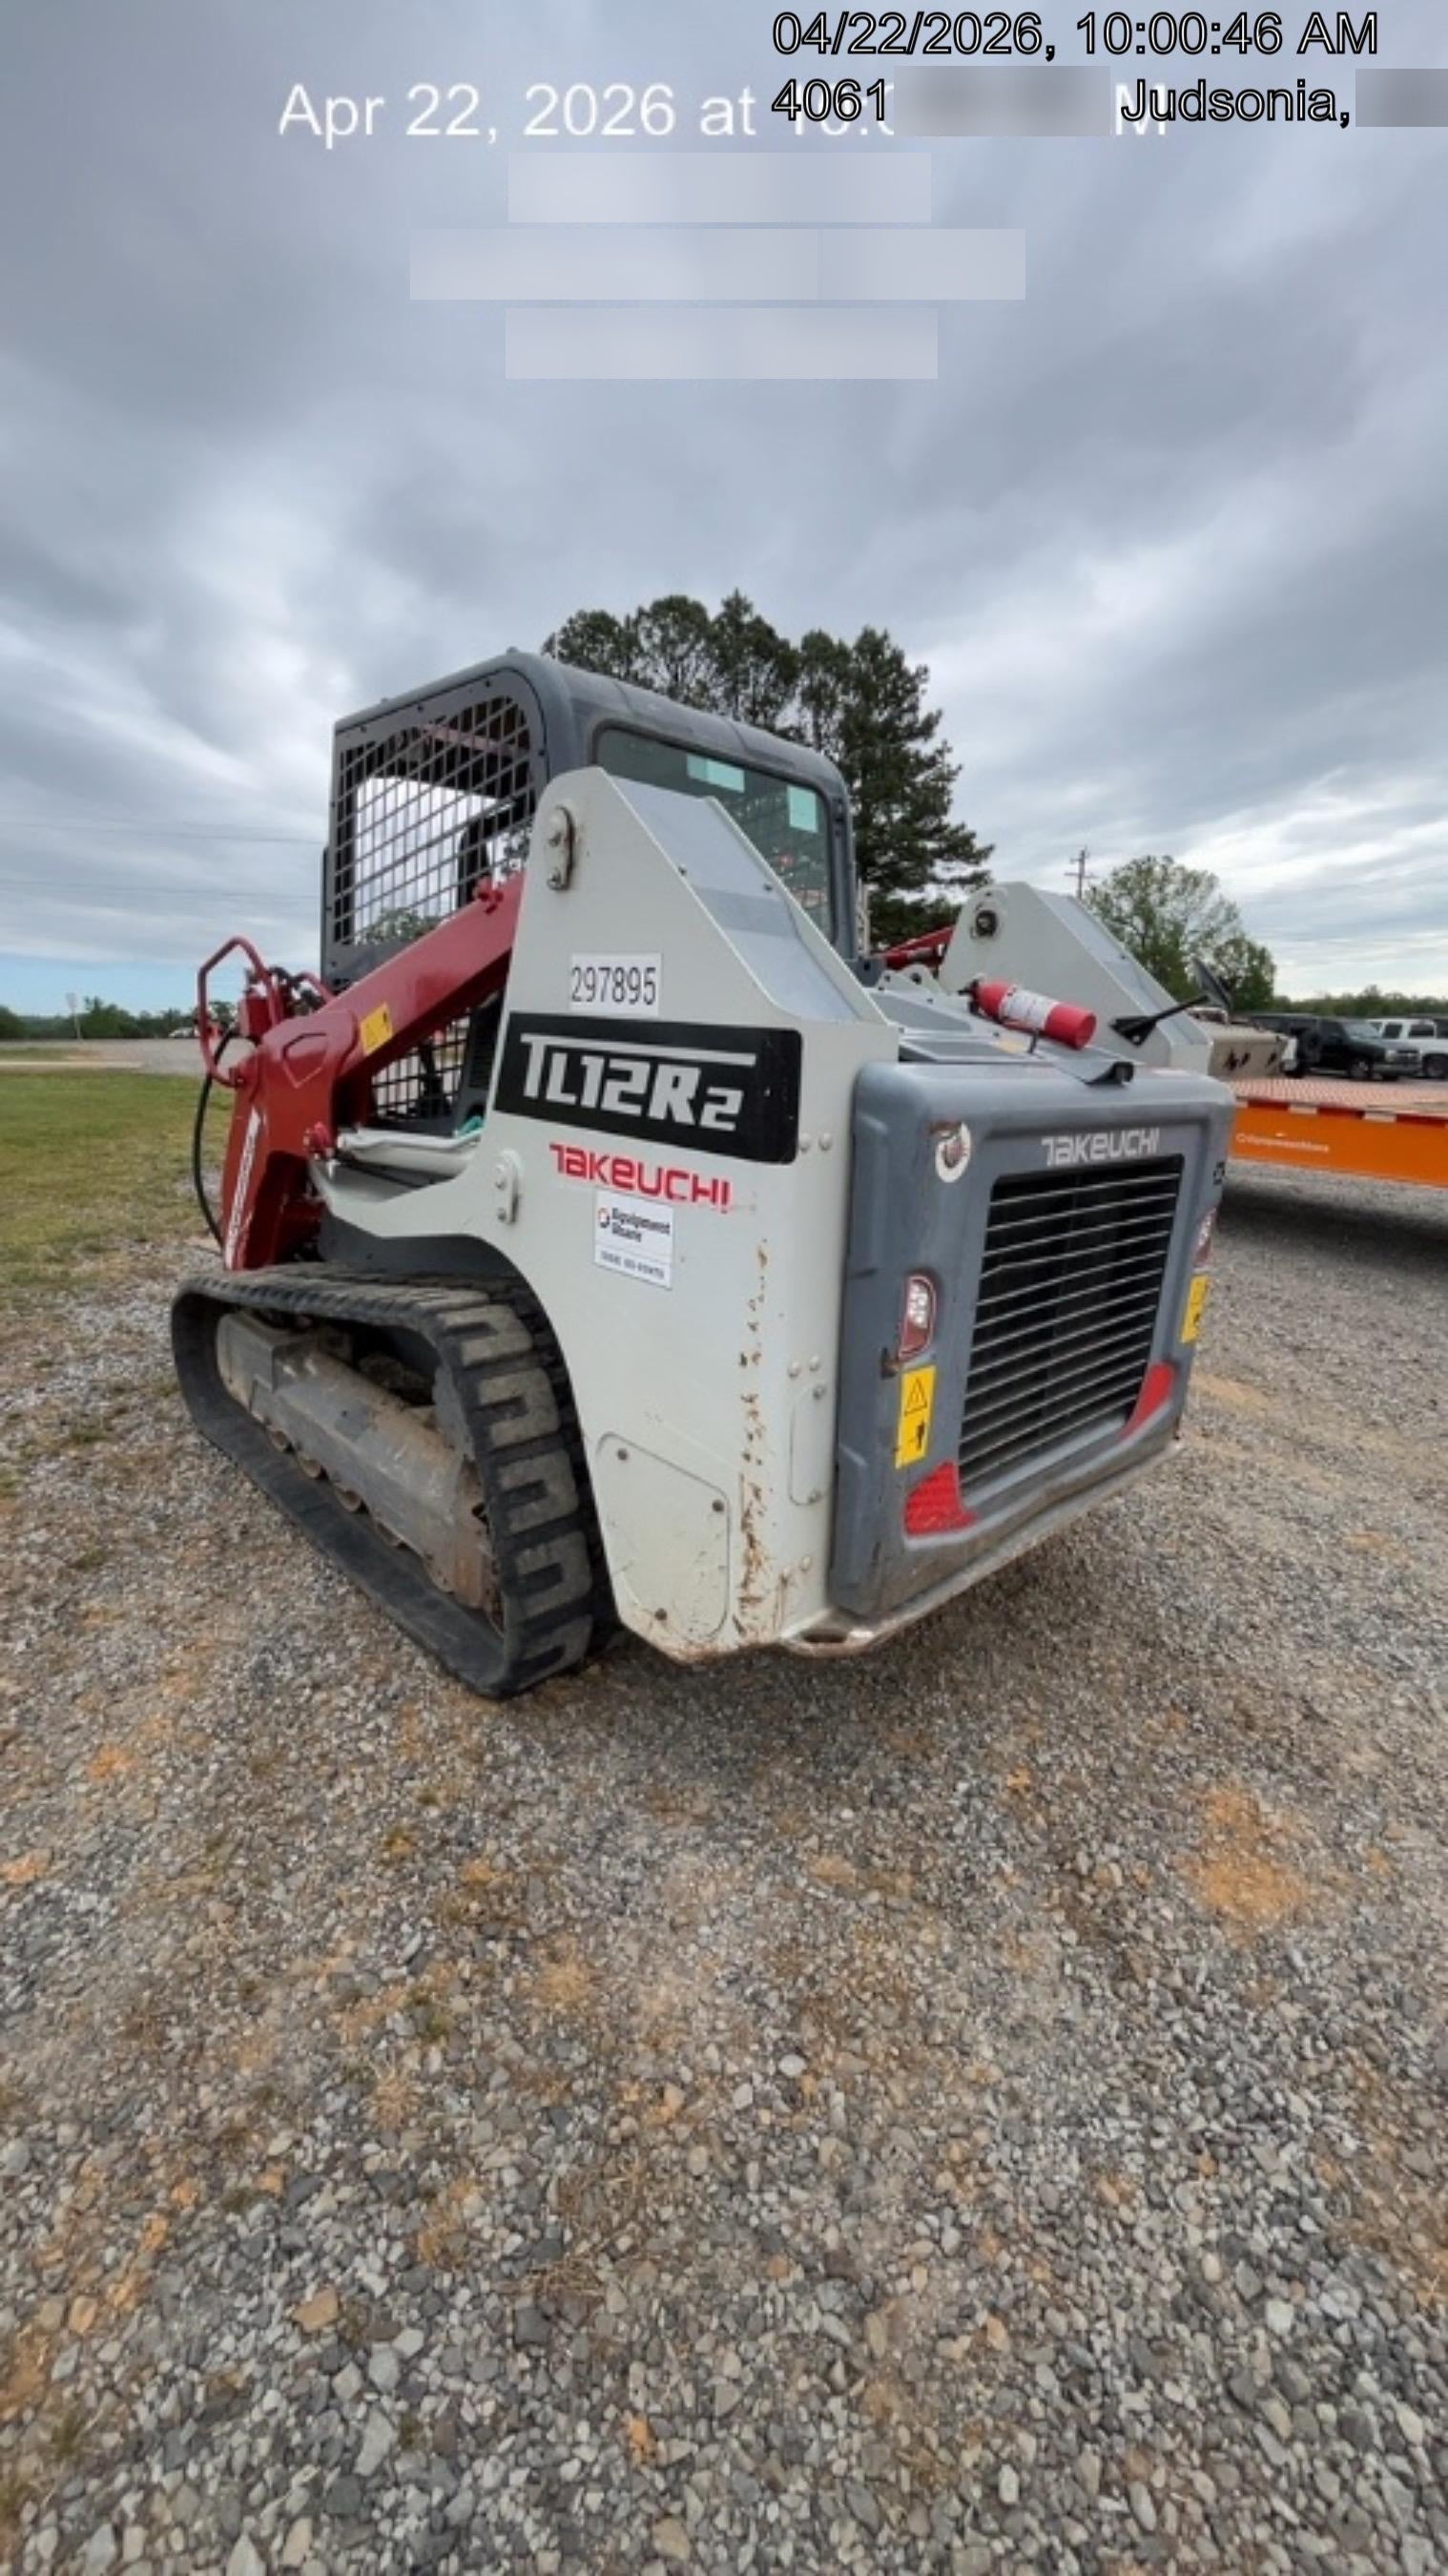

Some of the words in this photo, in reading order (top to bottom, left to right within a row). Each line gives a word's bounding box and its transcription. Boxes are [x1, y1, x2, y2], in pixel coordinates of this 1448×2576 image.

[571, 966, 656, 1006] 297895
[520, 1033, 756, 1132] TL12R2
[1041, 1127, 1160, 1166] TAKEUCHI
[549, 1143, 732, 1206] TAKEUCHI
